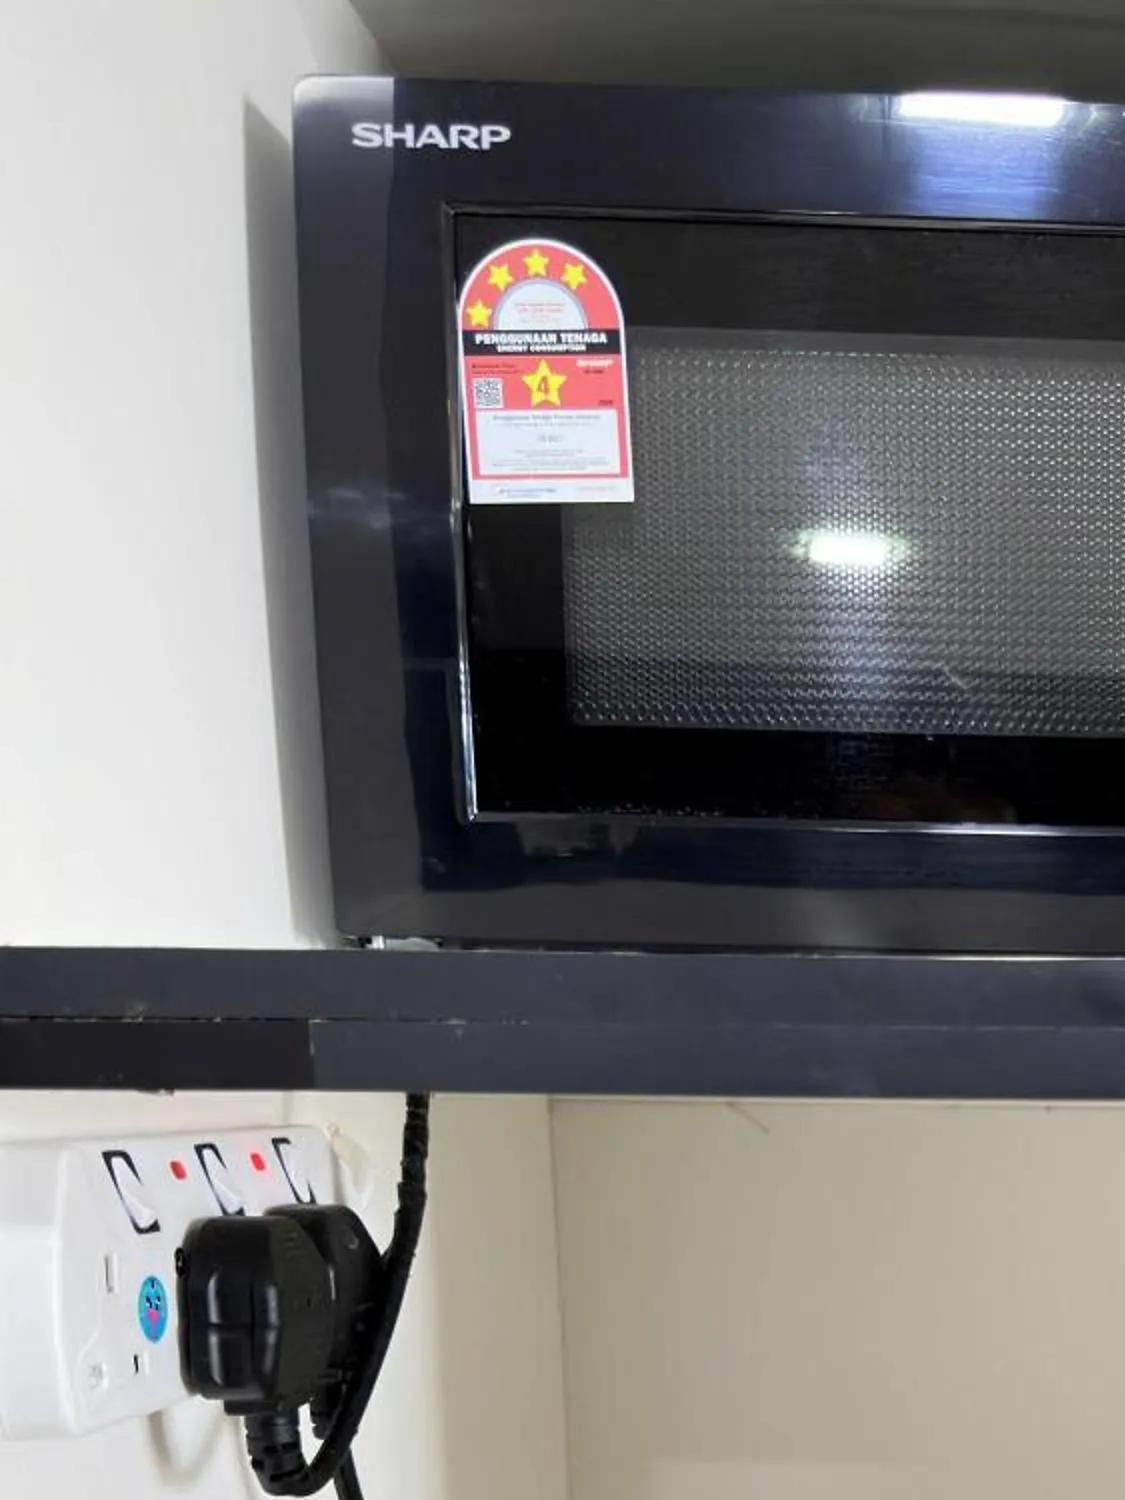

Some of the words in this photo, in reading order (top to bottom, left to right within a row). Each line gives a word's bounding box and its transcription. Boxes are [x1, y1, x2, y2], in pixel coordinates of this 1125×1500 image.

[351, 121, 511, 151] SHARP
[474, 332, 557, 345] PENGGUNAAN
[560, 331, 608, 344] TENAGA
